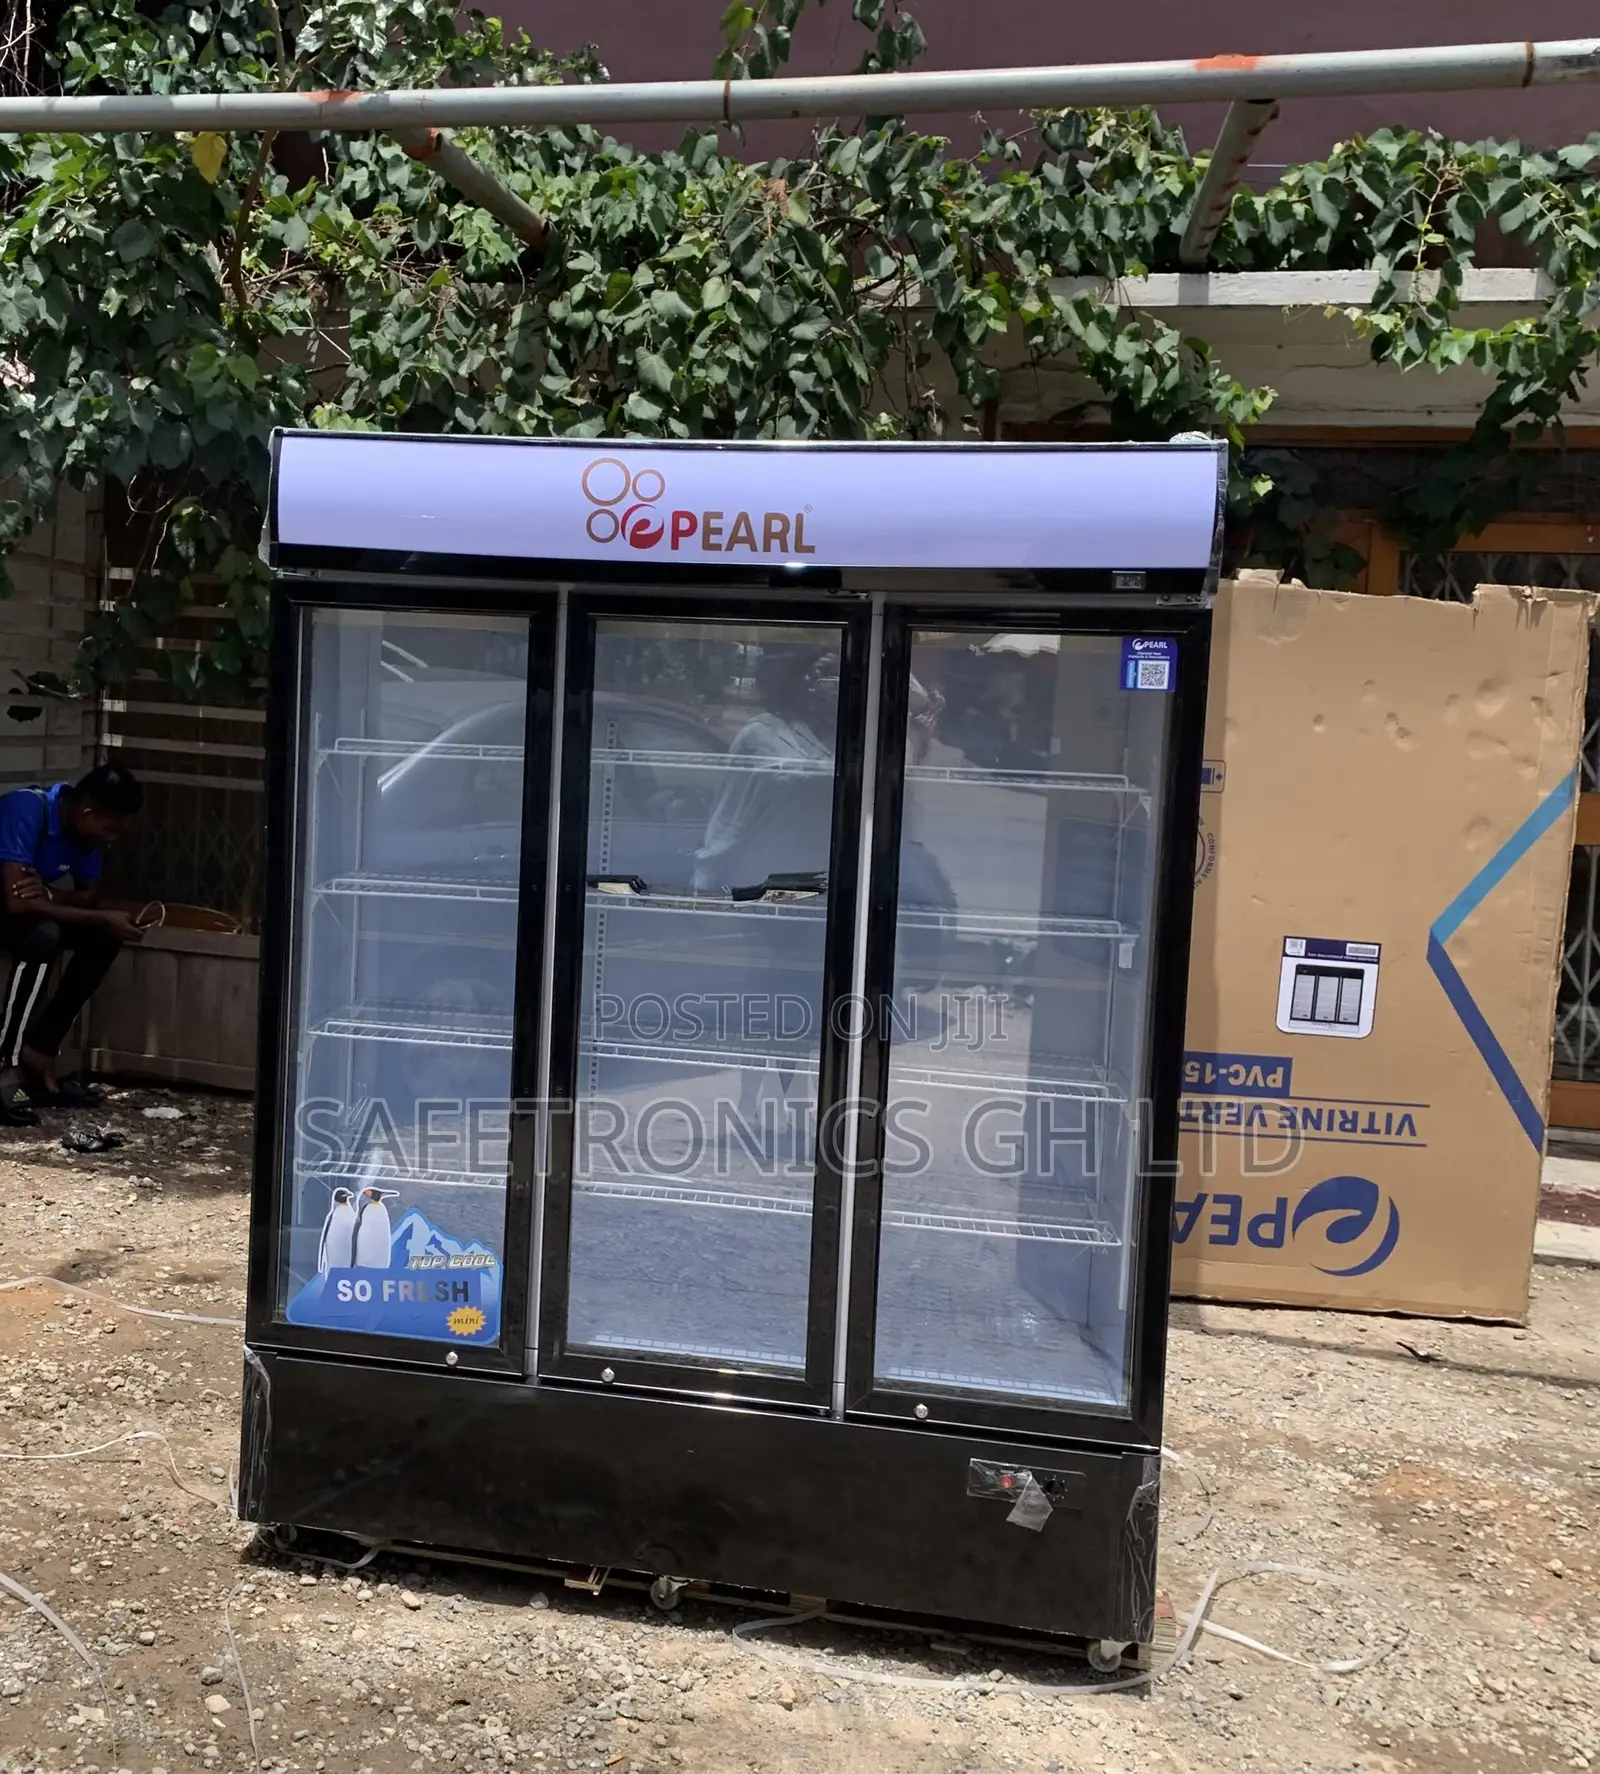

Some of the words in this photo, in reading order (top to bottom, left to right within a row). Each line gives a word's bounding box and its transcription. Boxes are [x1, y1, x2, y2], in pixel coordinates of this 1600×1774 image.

[670, 510, 816, 554] PEARL
[1144, 641, 1168, 649] PEARL
[1201, 832, 1216, 879] CONFORME
[1278, 1107, 1418, 1137] VITRINE
[408, 1256, 446, 1271] TOP
[449, 1254, 499, 1269] COOL
[336, 1279, 373, 1302] SO
[382, 1280, 470, 1303] FRESH
[453, 1315, 480, 1325] mini
